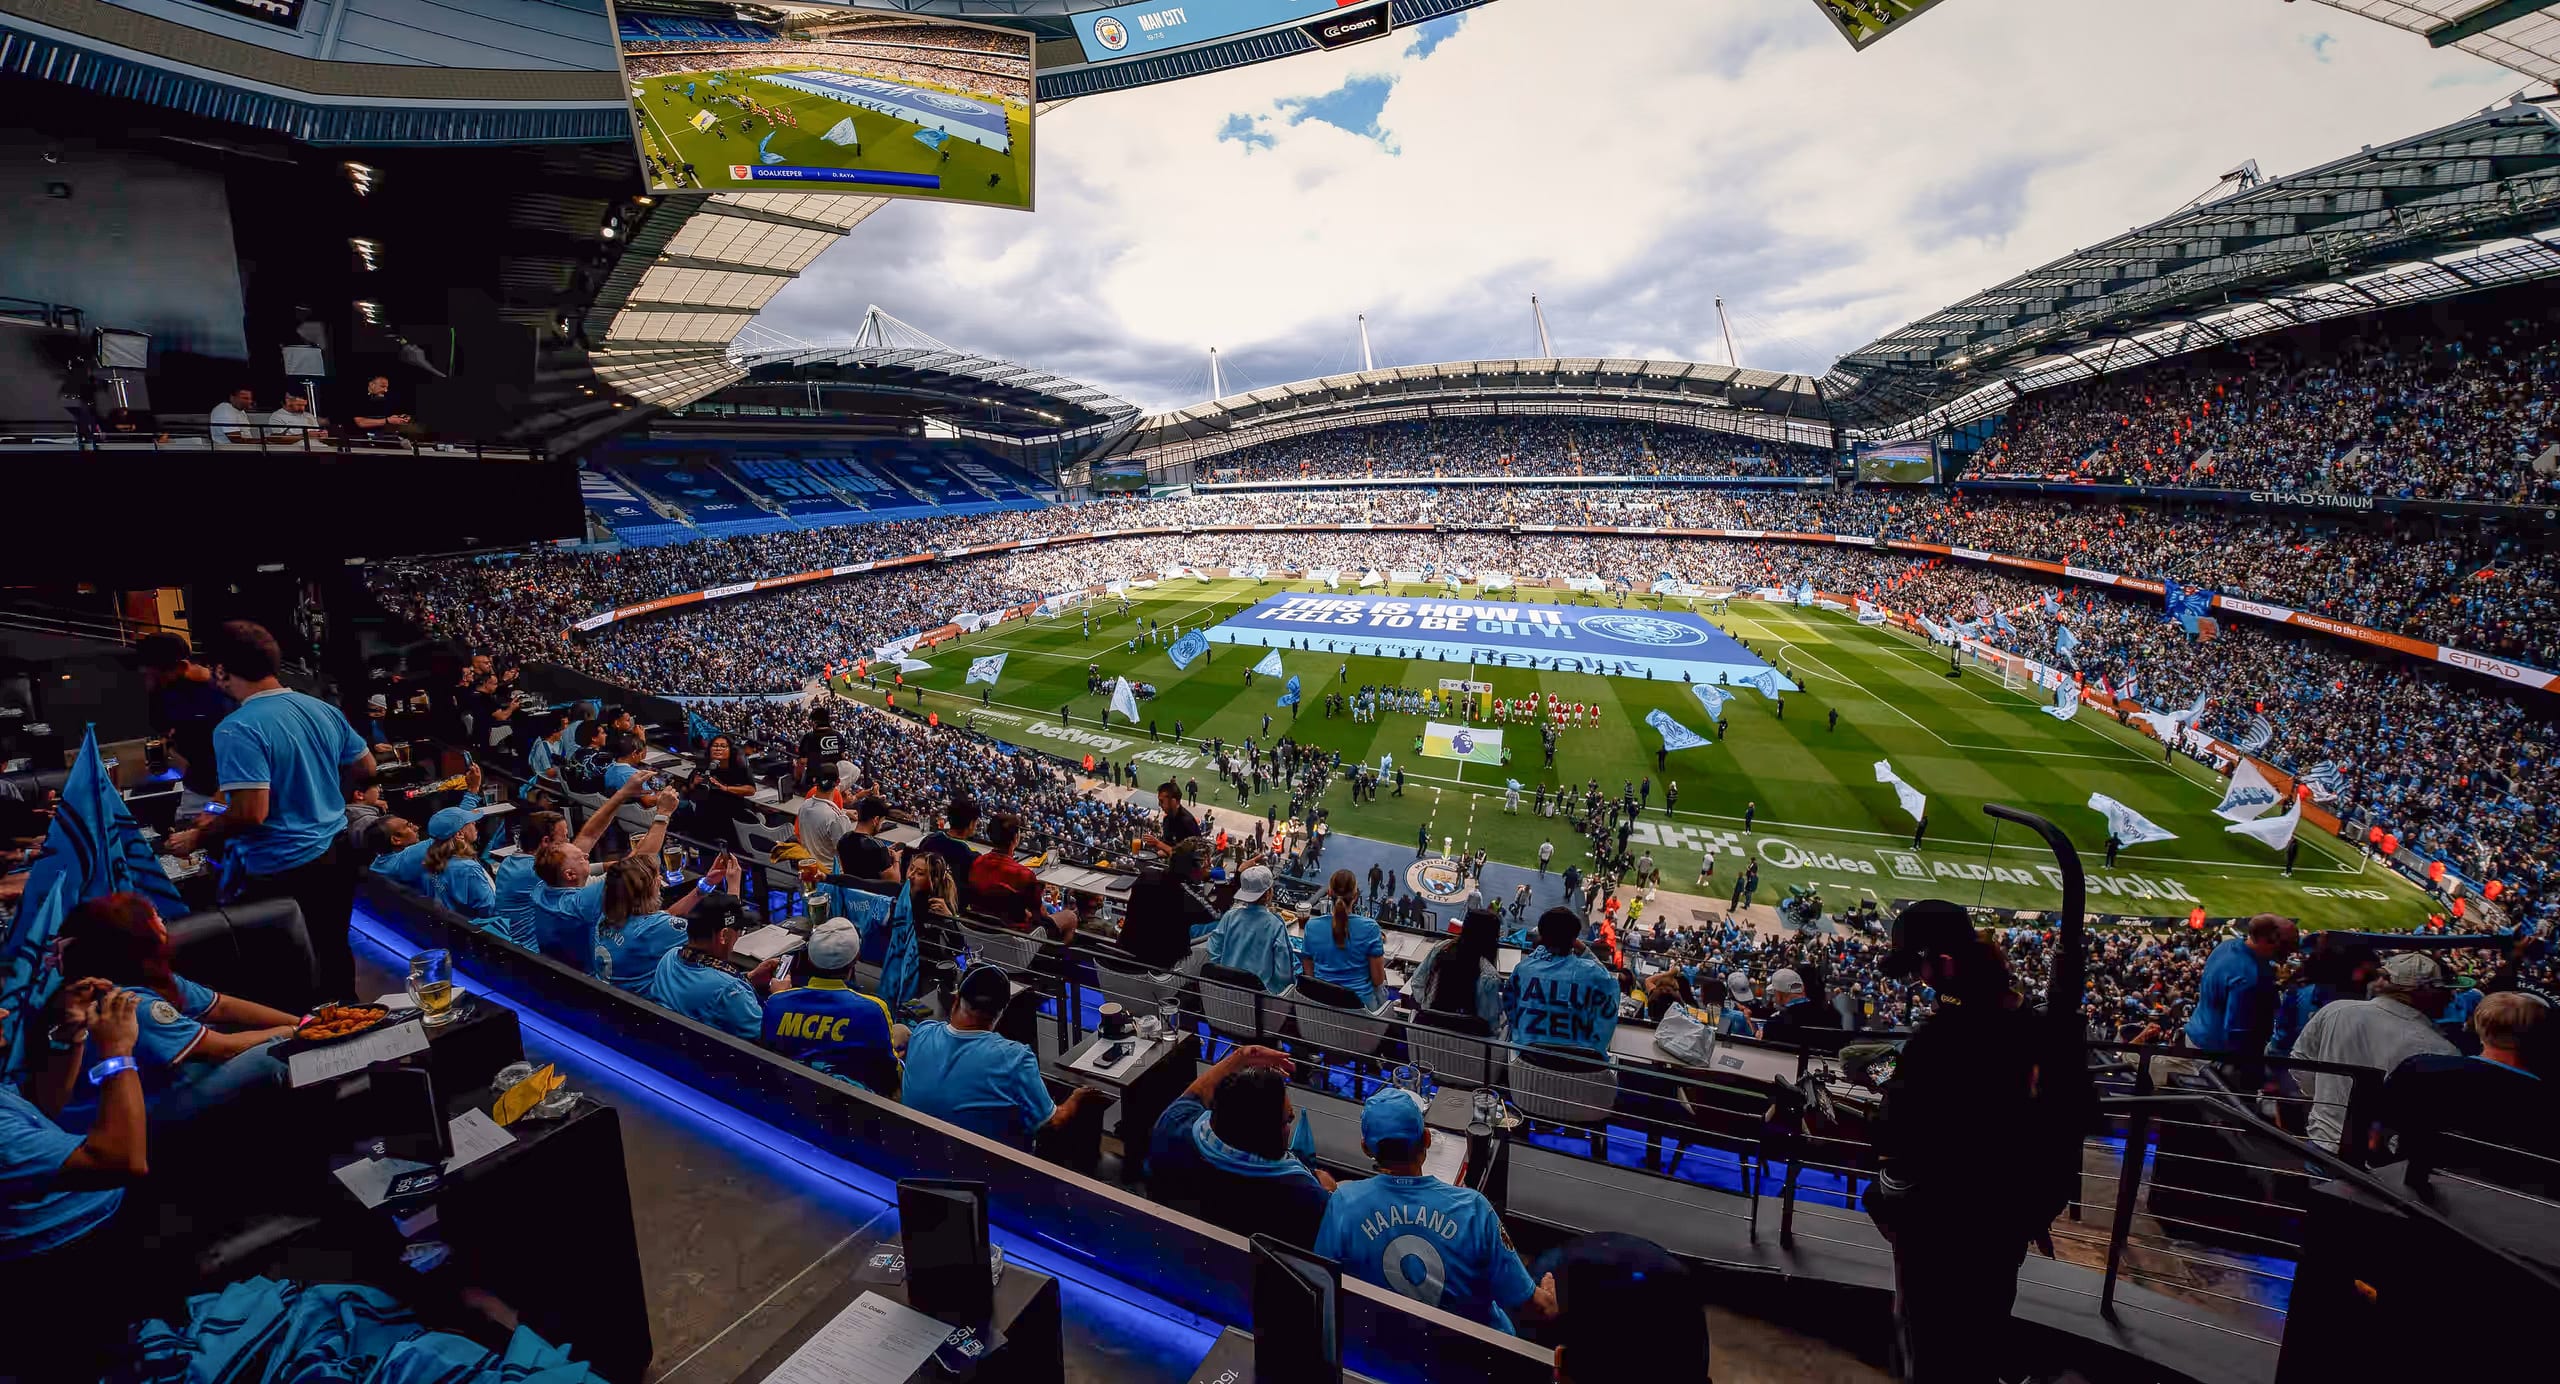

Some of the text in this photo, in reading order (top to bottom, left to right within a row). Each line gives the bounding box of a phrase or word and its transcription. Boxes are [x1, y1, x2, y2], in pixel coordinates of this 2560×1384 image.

[1137, 8, 1188, 32] MAN CITY
[758, 169, 802, 177] GOALKEEPER
[2249, 491, 2373, 509] ETIHAD STADIUM
[760, 578, 782, 588] Welcome
[2070, 569, 2104, 581] ETIHAD
[2120, 578, 2144, 590] Welcome
[2152, 582, 2164, 592] the
[707, 585, 743, 598] ETIHAD
[617, 606, 639, 617] Welcome
[1281, 597, 1564, 625] THIS IS HOW IT
[2225, 599, 2272, 616] ETIHAD
[1255, 608, 1577, 640] FEELS TO BE CITY!
[2296, 614, 2332, 631] Welcome
[2333, 623, 2342, 634] to
[2343, 624, 2358, 637] the
[2358, 630, 2386, 644] Etihad
[1318, 637, 1460, 656] Presented by
[1634, 636, 1672, 645] CITY
[1471, 647, 1644, 675] Revolut
[2448, 652, 2521, 679] ETIHAD
[1024, 720, 1135, 754] betway
[1780, 846, 1878, 875] Midea
[1933, 860, 2042, 887] ALDAR
[1426, 894, 1449, 903] CITY
[2301, 885, 2391, 901] ETIHAD
[775, 1011, 851, 1042] MCFC
[1360, 1204, 1458, 1241] HAALAND
[946, 1325, 977, 1346] 158
